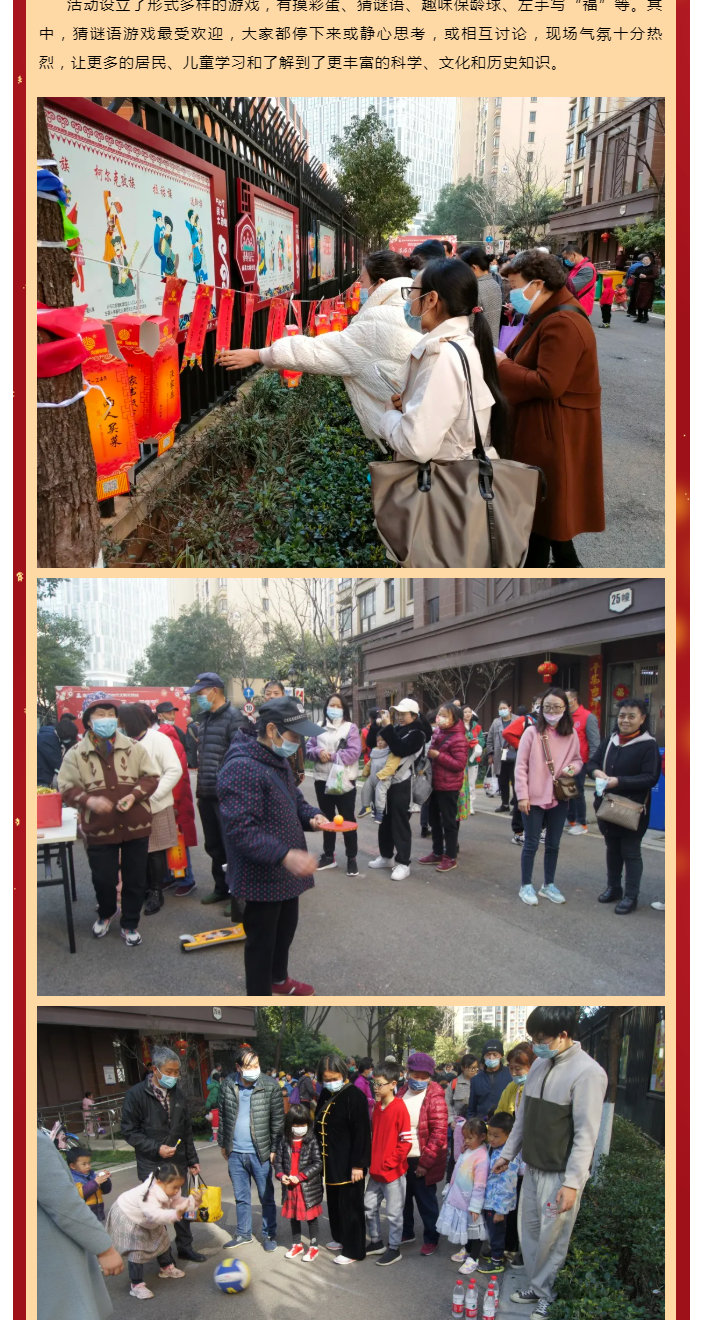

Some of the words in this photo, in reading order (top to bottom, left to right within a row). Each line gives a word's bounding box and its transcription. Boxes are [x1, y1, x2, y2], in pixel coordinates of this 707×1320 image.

[39, 26, 663, 42] 中，猜谜语游戏最受欢迎，大家都停下来或静心思考，或相互讨论，现场气氛十分热
[38, 54, 560, 71] 烈，让更多的居民、儿童学习和了解到了更丰富的科学、文化和历史知识。
